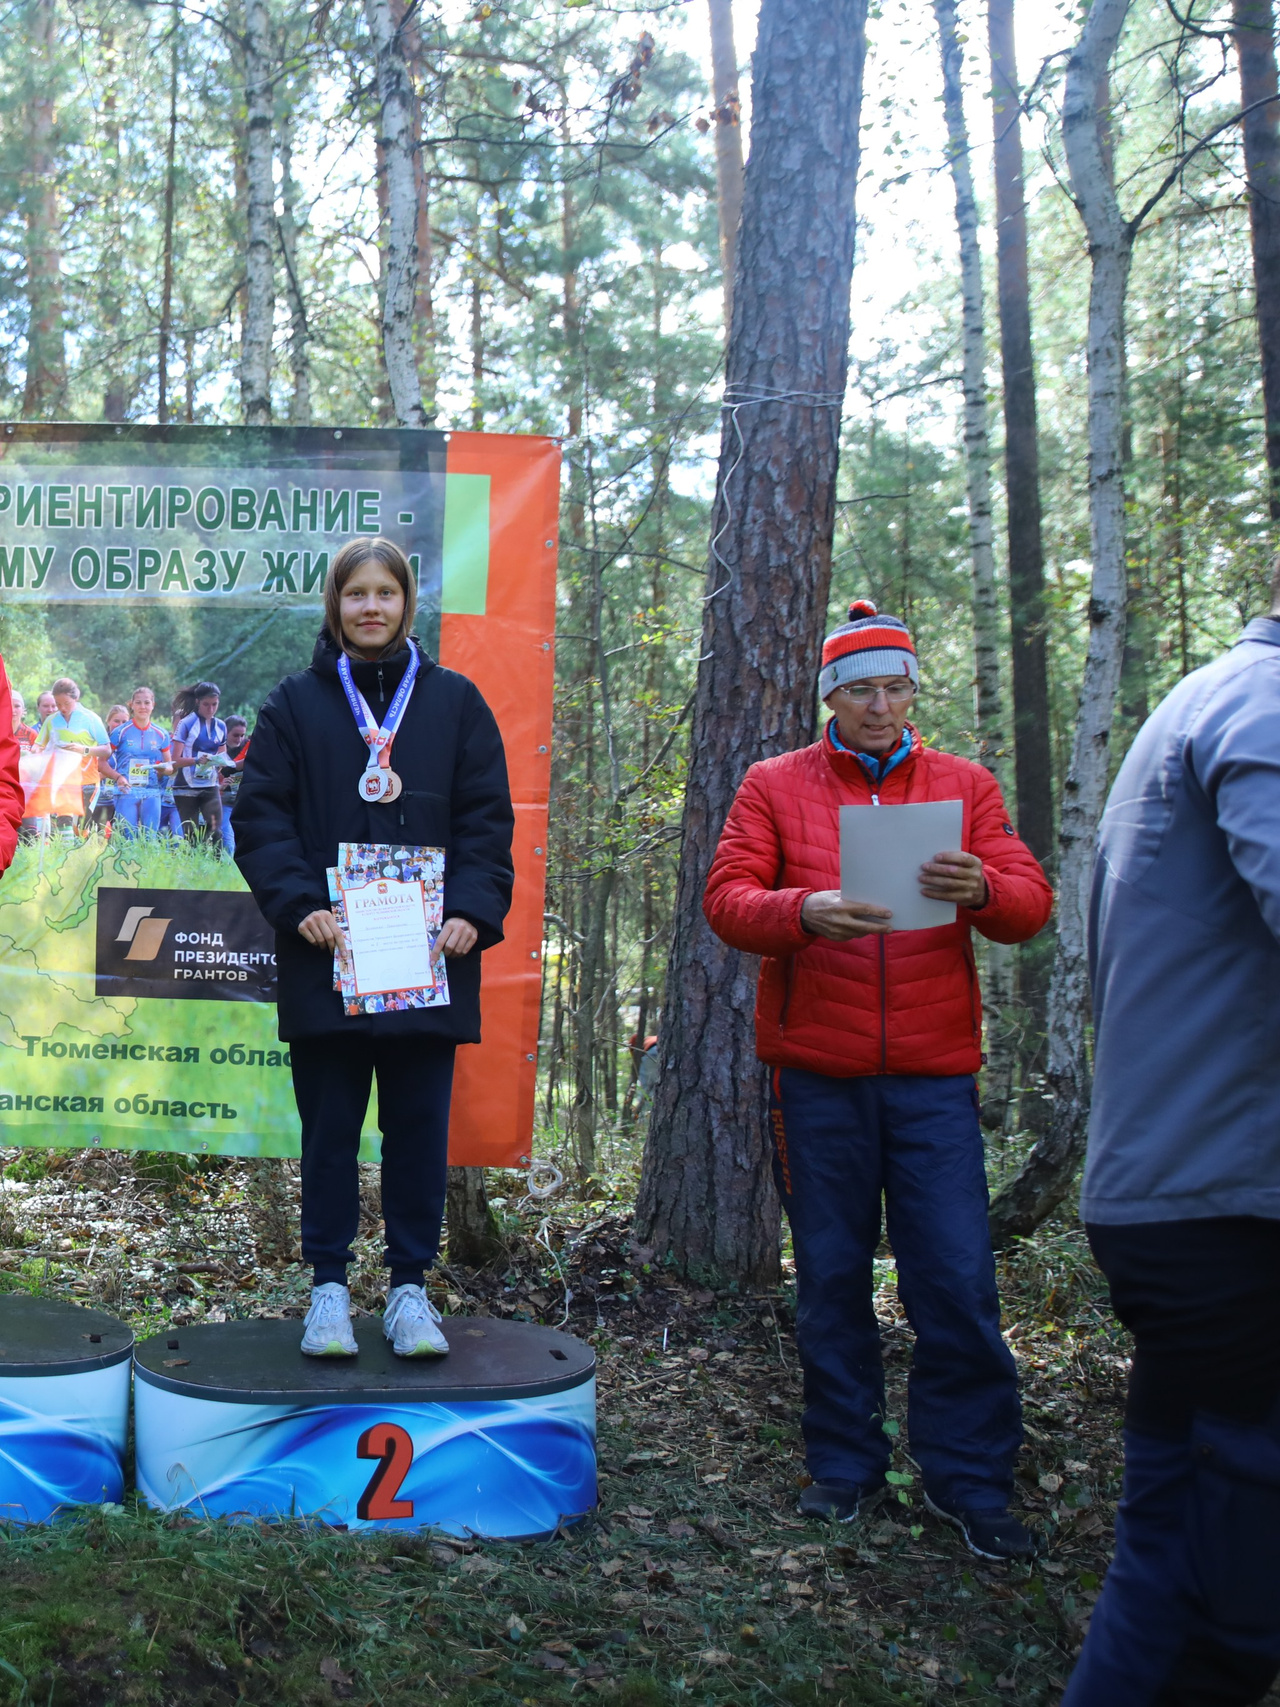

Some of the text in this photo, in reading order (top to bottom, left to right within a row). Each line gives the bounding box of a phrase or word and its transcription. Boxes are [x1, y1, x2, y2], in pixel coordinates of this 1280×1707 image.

[71, 547, 246, 593] ОБРАЗУ
[355, 894, 415, 909] ГРАМОТА
[174, 931, 224, 947] ФОНД
[174, 969, 248, 981] ГРАНТОВ
[21, 1035, 200, 1064] Тюменская
[113, 1092, 238, 1120] область
[356, 1421, 414, 1521] 2
